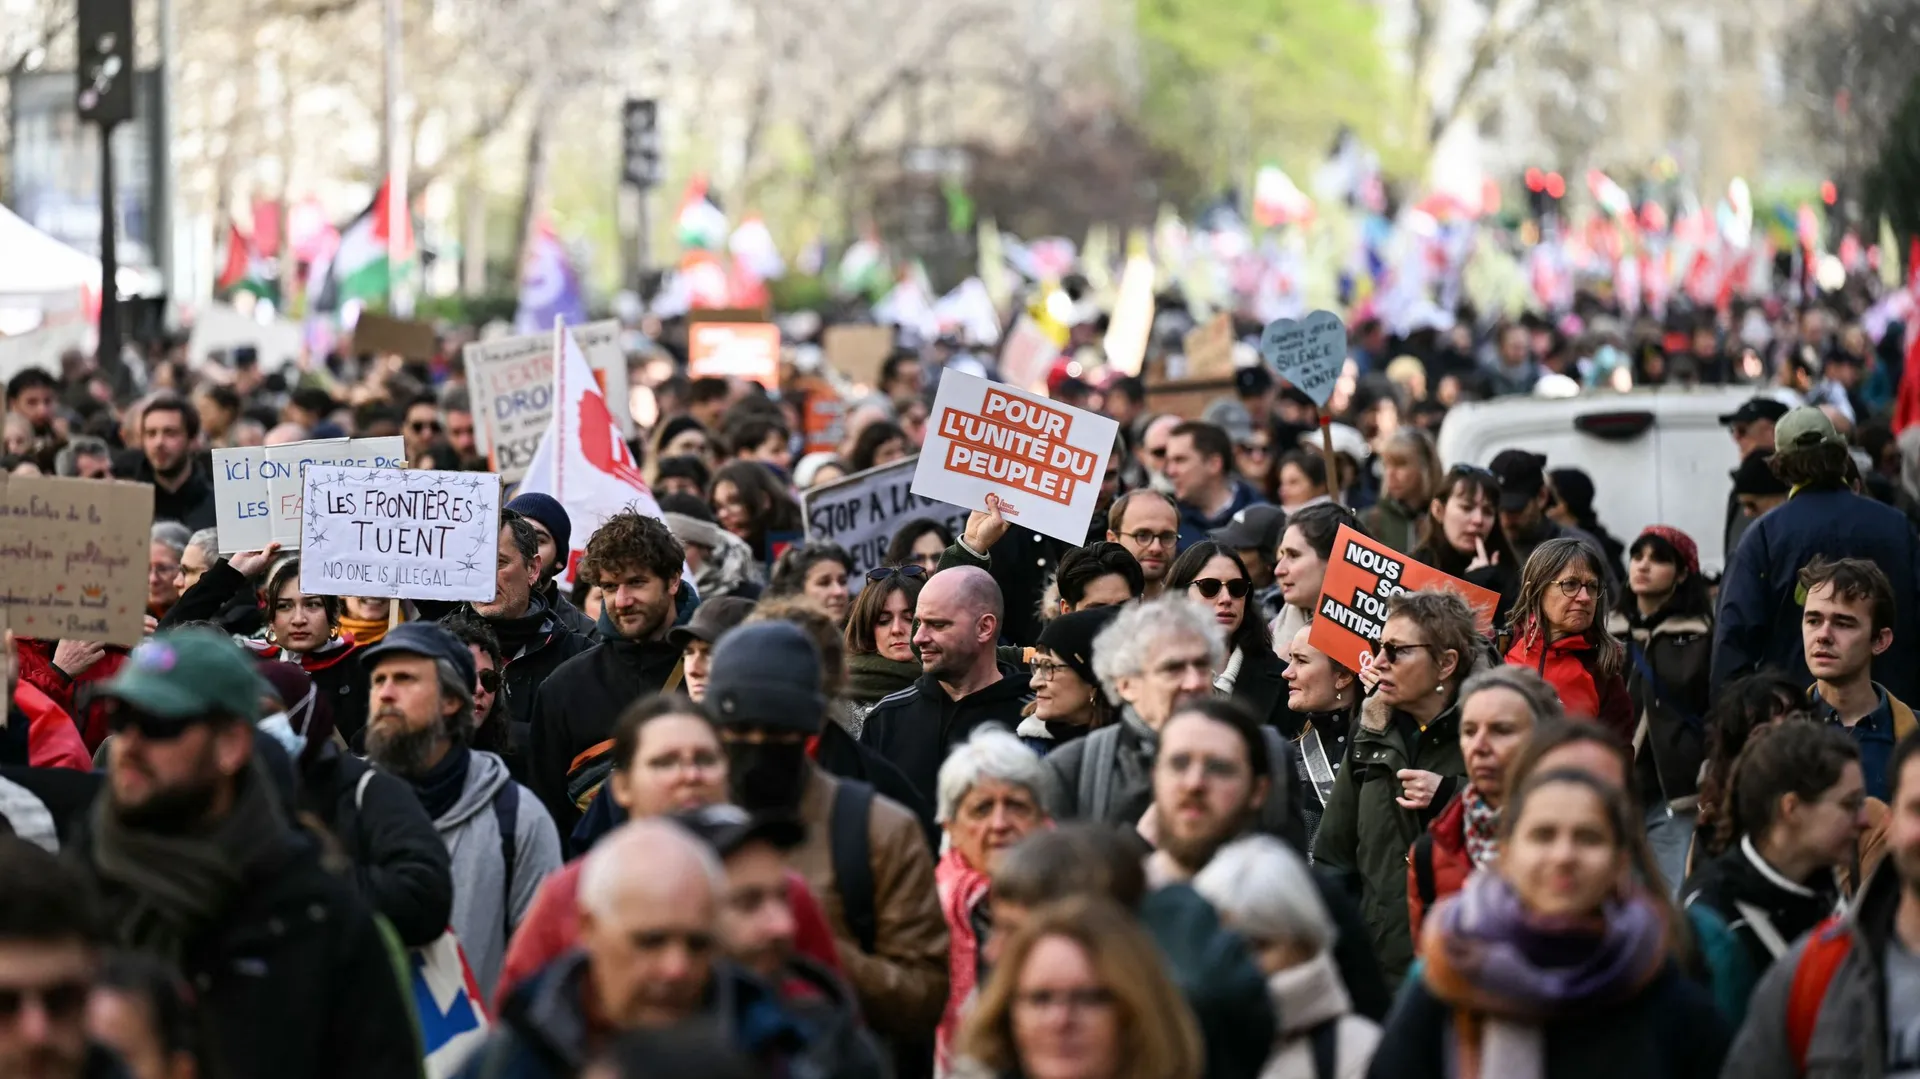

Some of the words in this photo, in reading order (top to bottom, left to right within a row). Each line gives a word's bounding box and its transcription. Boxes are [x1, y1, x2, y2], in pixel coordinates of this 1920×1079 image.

[494, 381, 553, 420] DRO
[985, 393, 1066, 439] POUR
[944, 412, 1049, 462] L'UNITÉ
[1050, 444, 1092, 476] DU
[259, 460, 291, 479] ON
[950, 445, 1059, 496] PEUPLE
[238, 501, 269, 519] LES
[281, 494, 303, 515] FA
[327, 490, 357, 515] LES
[364, 489, 473, 523] FRONTIÈRES
[810, 497, 862, 539] STOP
[870, 492, 886, 525] A
[351, 520, 455, 559] TUENT
[323, 561, 343, 580] NO
[347, 562, 373, 583] ONE
[378, 565, 389, 584] IS
[395, 566, 453, 587] ILLEGAL
[1346, 543, 1400, 580] NOUS
[1322, 599, 1382, 640] ANTIFA
[1355, 590, 1389, 622] TOU
